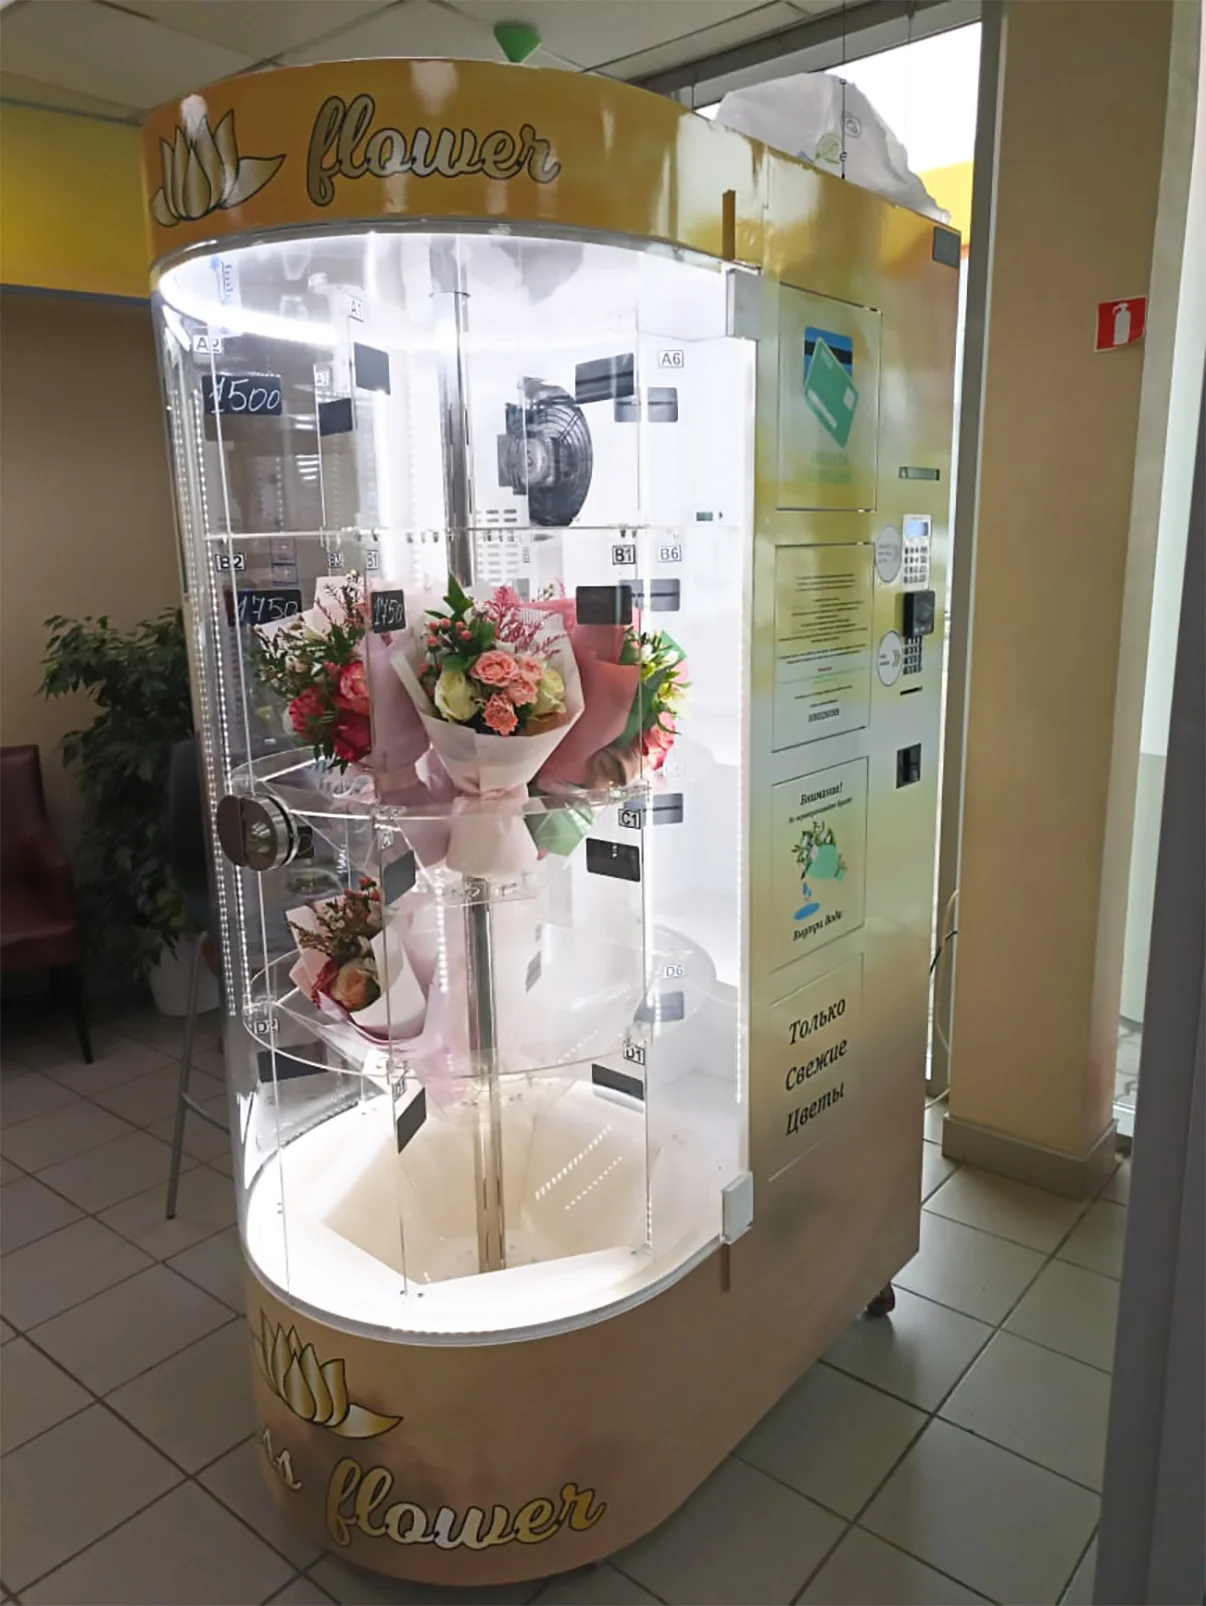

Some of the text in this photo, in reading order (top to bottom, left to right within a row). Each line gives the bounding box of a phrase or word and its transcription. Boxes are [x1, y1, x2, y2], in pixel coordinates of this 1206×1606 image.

[305, 94, 561, 207] flower
[661, 352, 682, 366] A6
[208, 376, 280, 414] 1500
[220, 554, 243, 569] B2
[615, 548, 632, 562] B1
[660, 547, 679, 561] B6
[621, 810, 639, 828] C1
[666, 965, 684, 978] D6
[789, 998, 846, 1045] Только
[785, 1039, 848, 1091] Свежие
[785, 1080, 845, 1136] Цветы
[325, 1456, 607, 1551] flower
